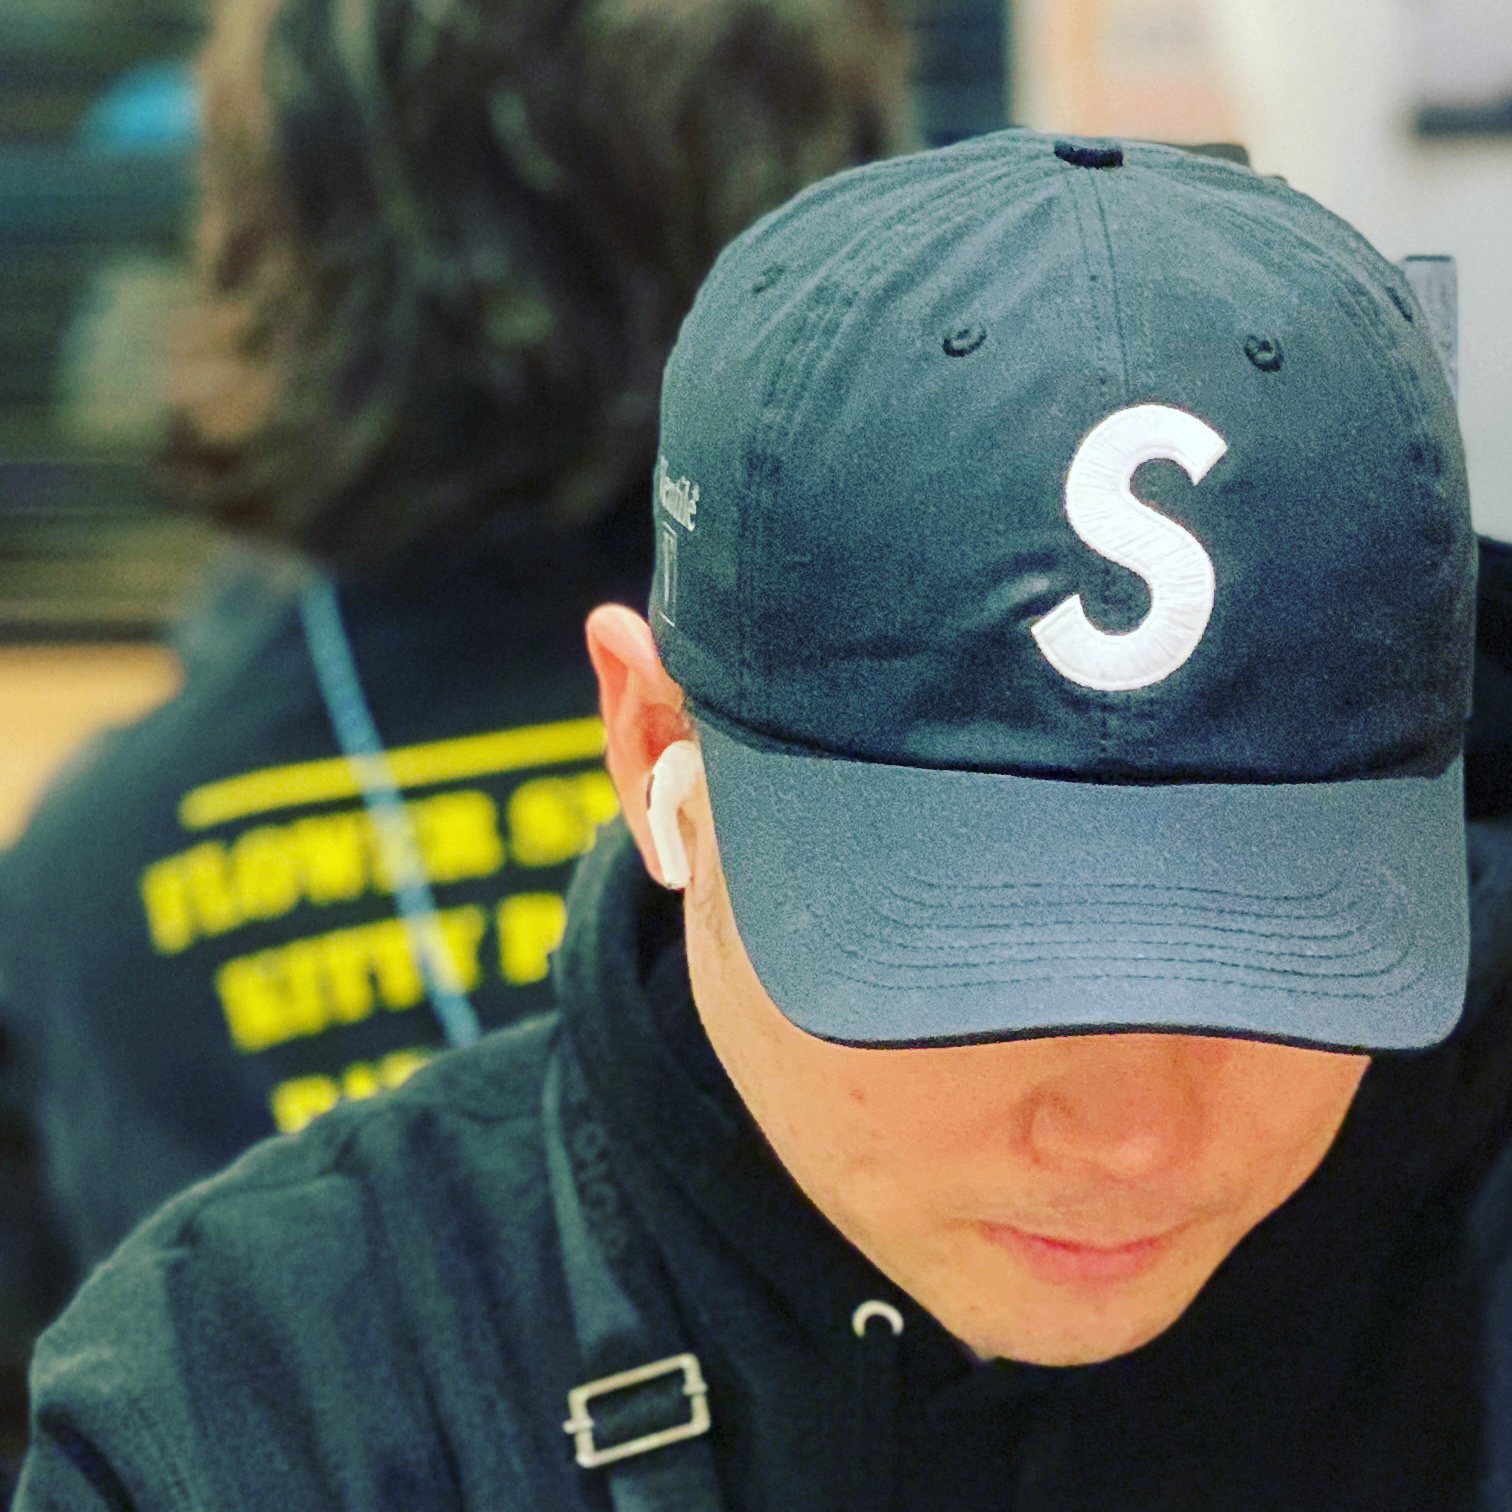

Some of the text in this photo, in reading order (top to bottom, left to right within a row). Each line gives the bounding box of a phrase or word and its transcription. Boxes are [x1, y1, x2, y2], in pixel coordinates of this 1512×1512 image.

[1031, 403, 1228, 692] S
[142, 791, 503, 952] FLOWER
[218, 907, 486, 1050] KITTY
